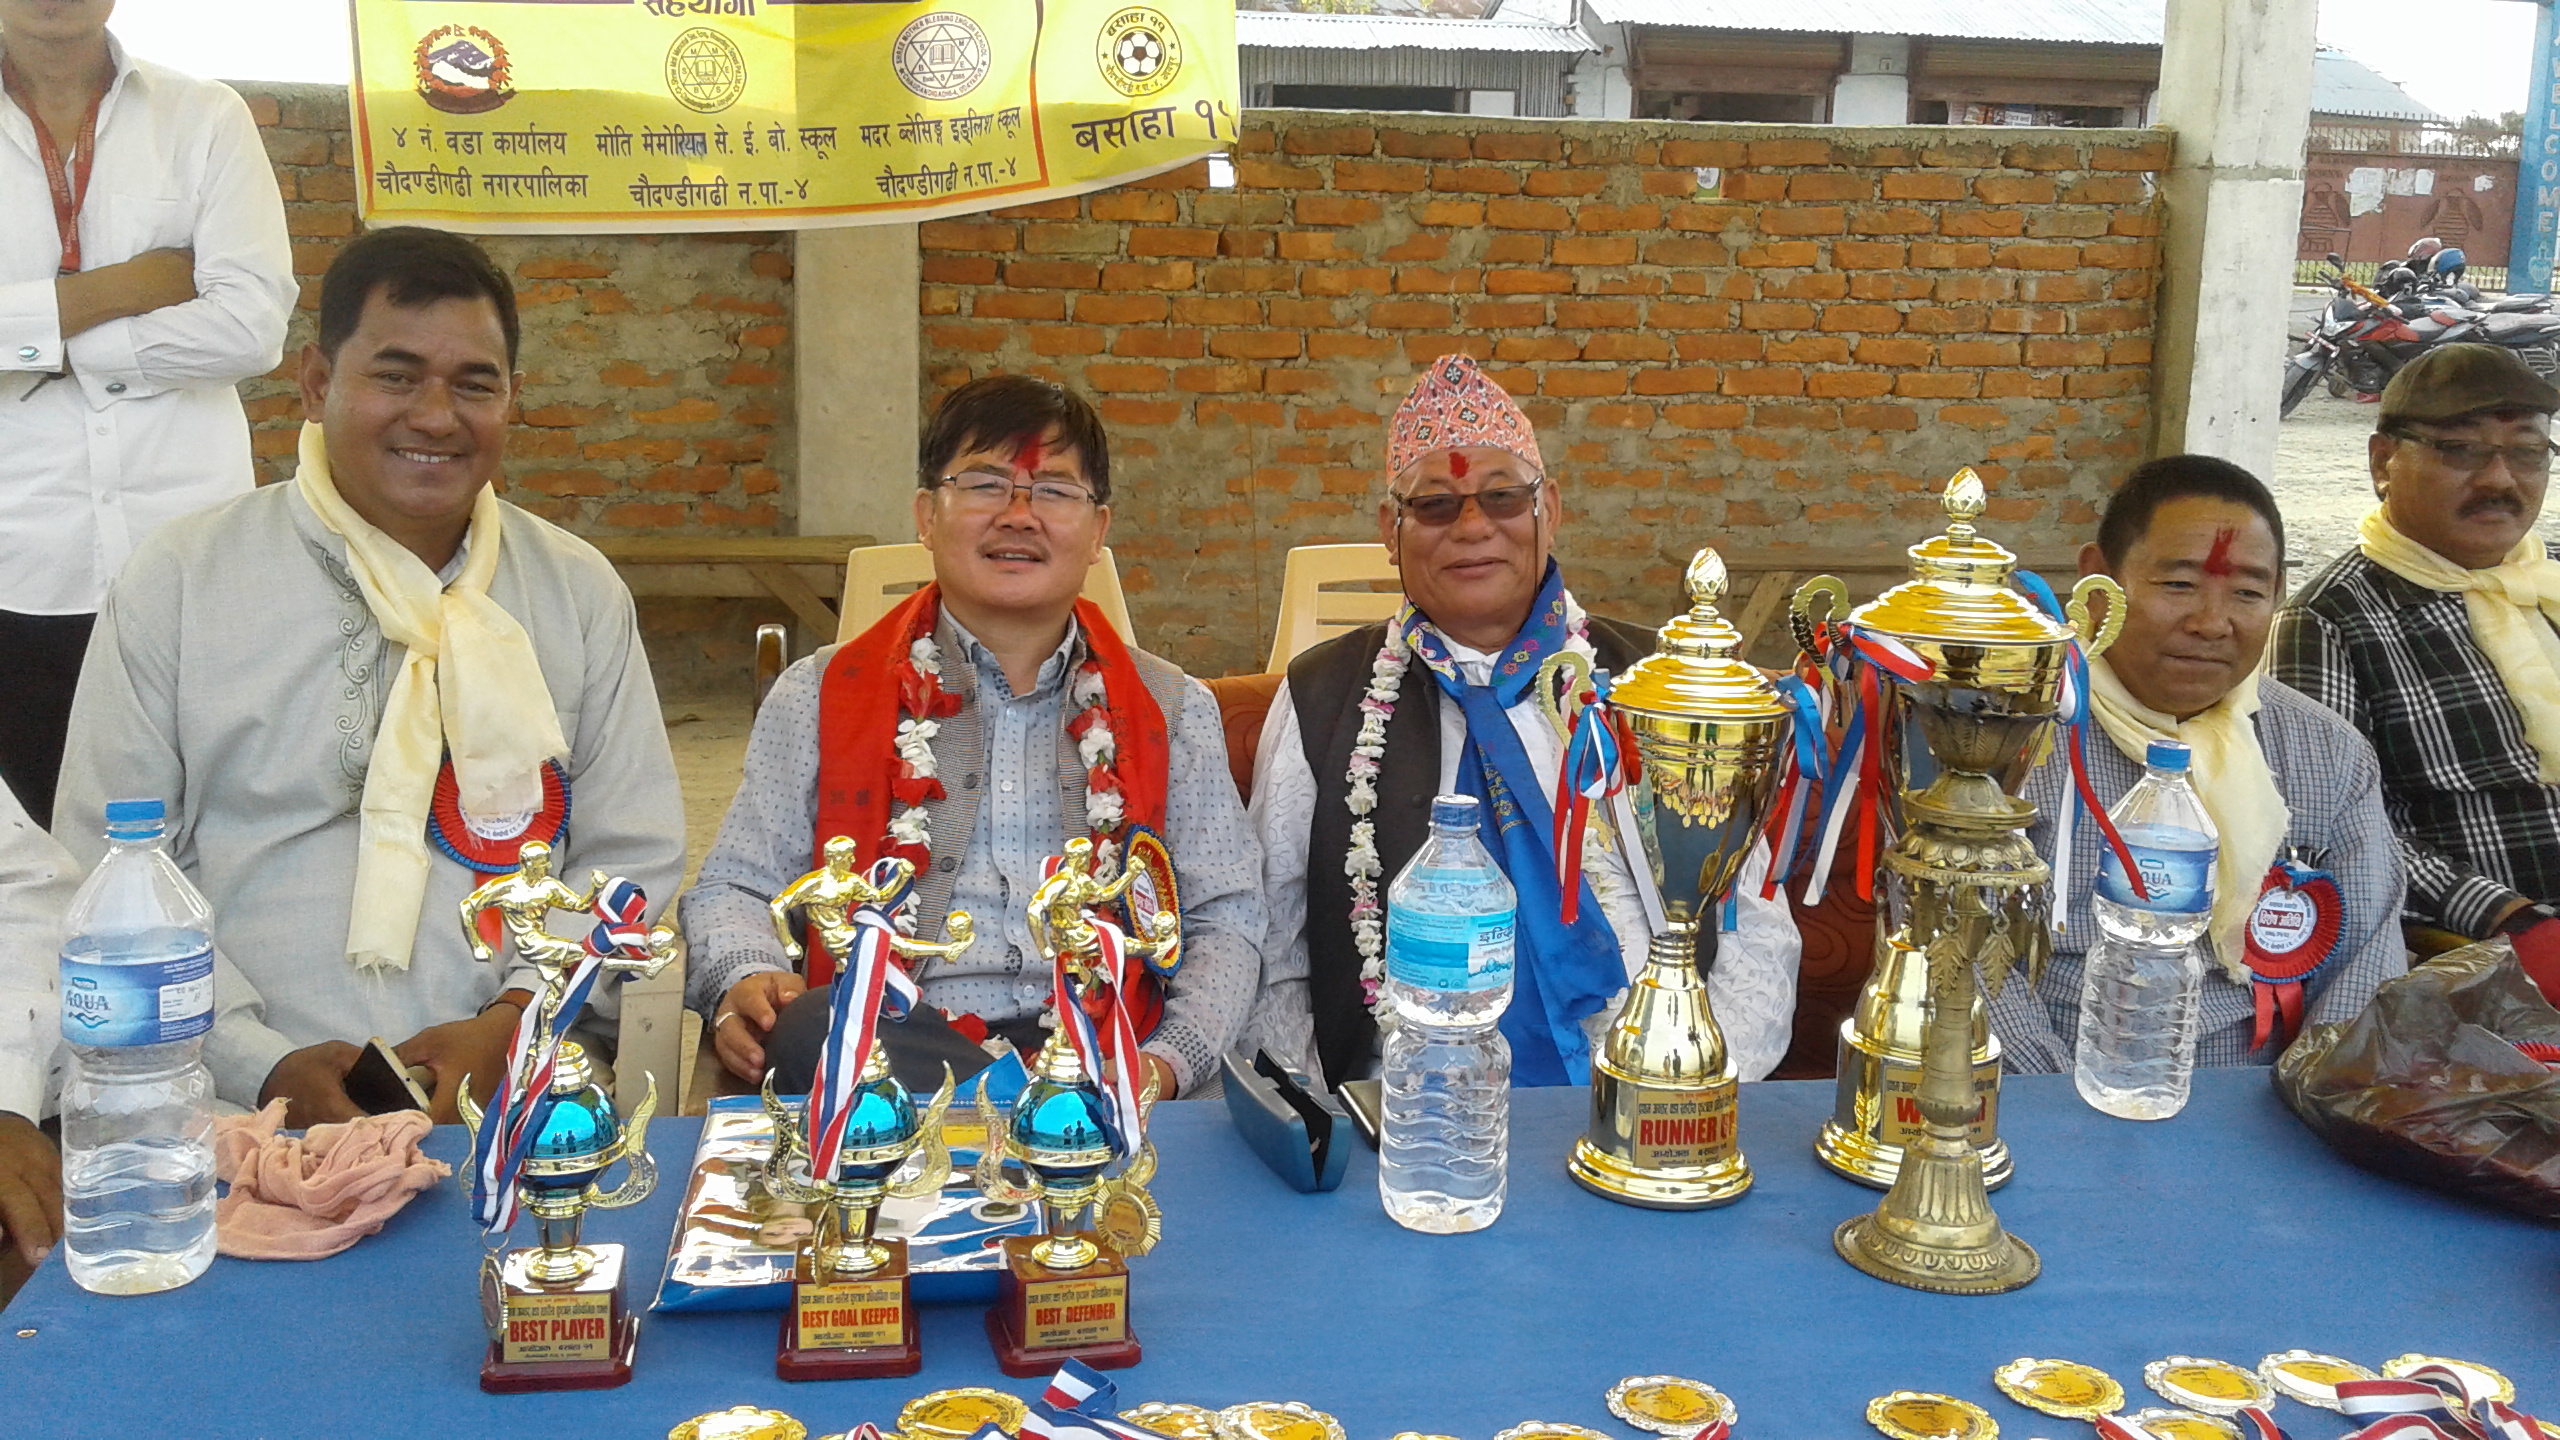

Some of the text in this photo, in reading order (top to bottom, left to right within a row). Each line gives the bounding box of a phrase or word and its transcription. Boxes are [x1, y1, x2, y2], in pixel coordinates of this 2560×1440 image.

[1106, 12, 1166, 36] बसाहा ११
[974, 31, 988, 57] SCHOOL
[391, 122, 568, 155] ४ नं. वडा कार्यालय
[595, 121, 838, 160] मोति मेमोरियल से. ई. बो. स्कूल
[859, 123, 892, 148] मदर
[997, 106, 1021, 139] स्कूल
[1071, 106, 1178, 155] बसाहा
[376, 161, 589, 198] चौदण्डीगढी नगरपालिका
[628, 172, 729, 208] चौदण्डीगढी
[876, 161, 959, 199] चौदण्डीगढी
[2139, 871, 2173, 886] QUA
[65, 990, 111, 1013] AQUA
[1640, 1110, 1736, 1146] RUNNER UP
[510, 1317, 605, 1342] BEST PLAYER
[802, 1306, 899, 1328] BEST GOAL KEEPER
[1036, 1302, 1116, 1326] BEST DEFENDER
